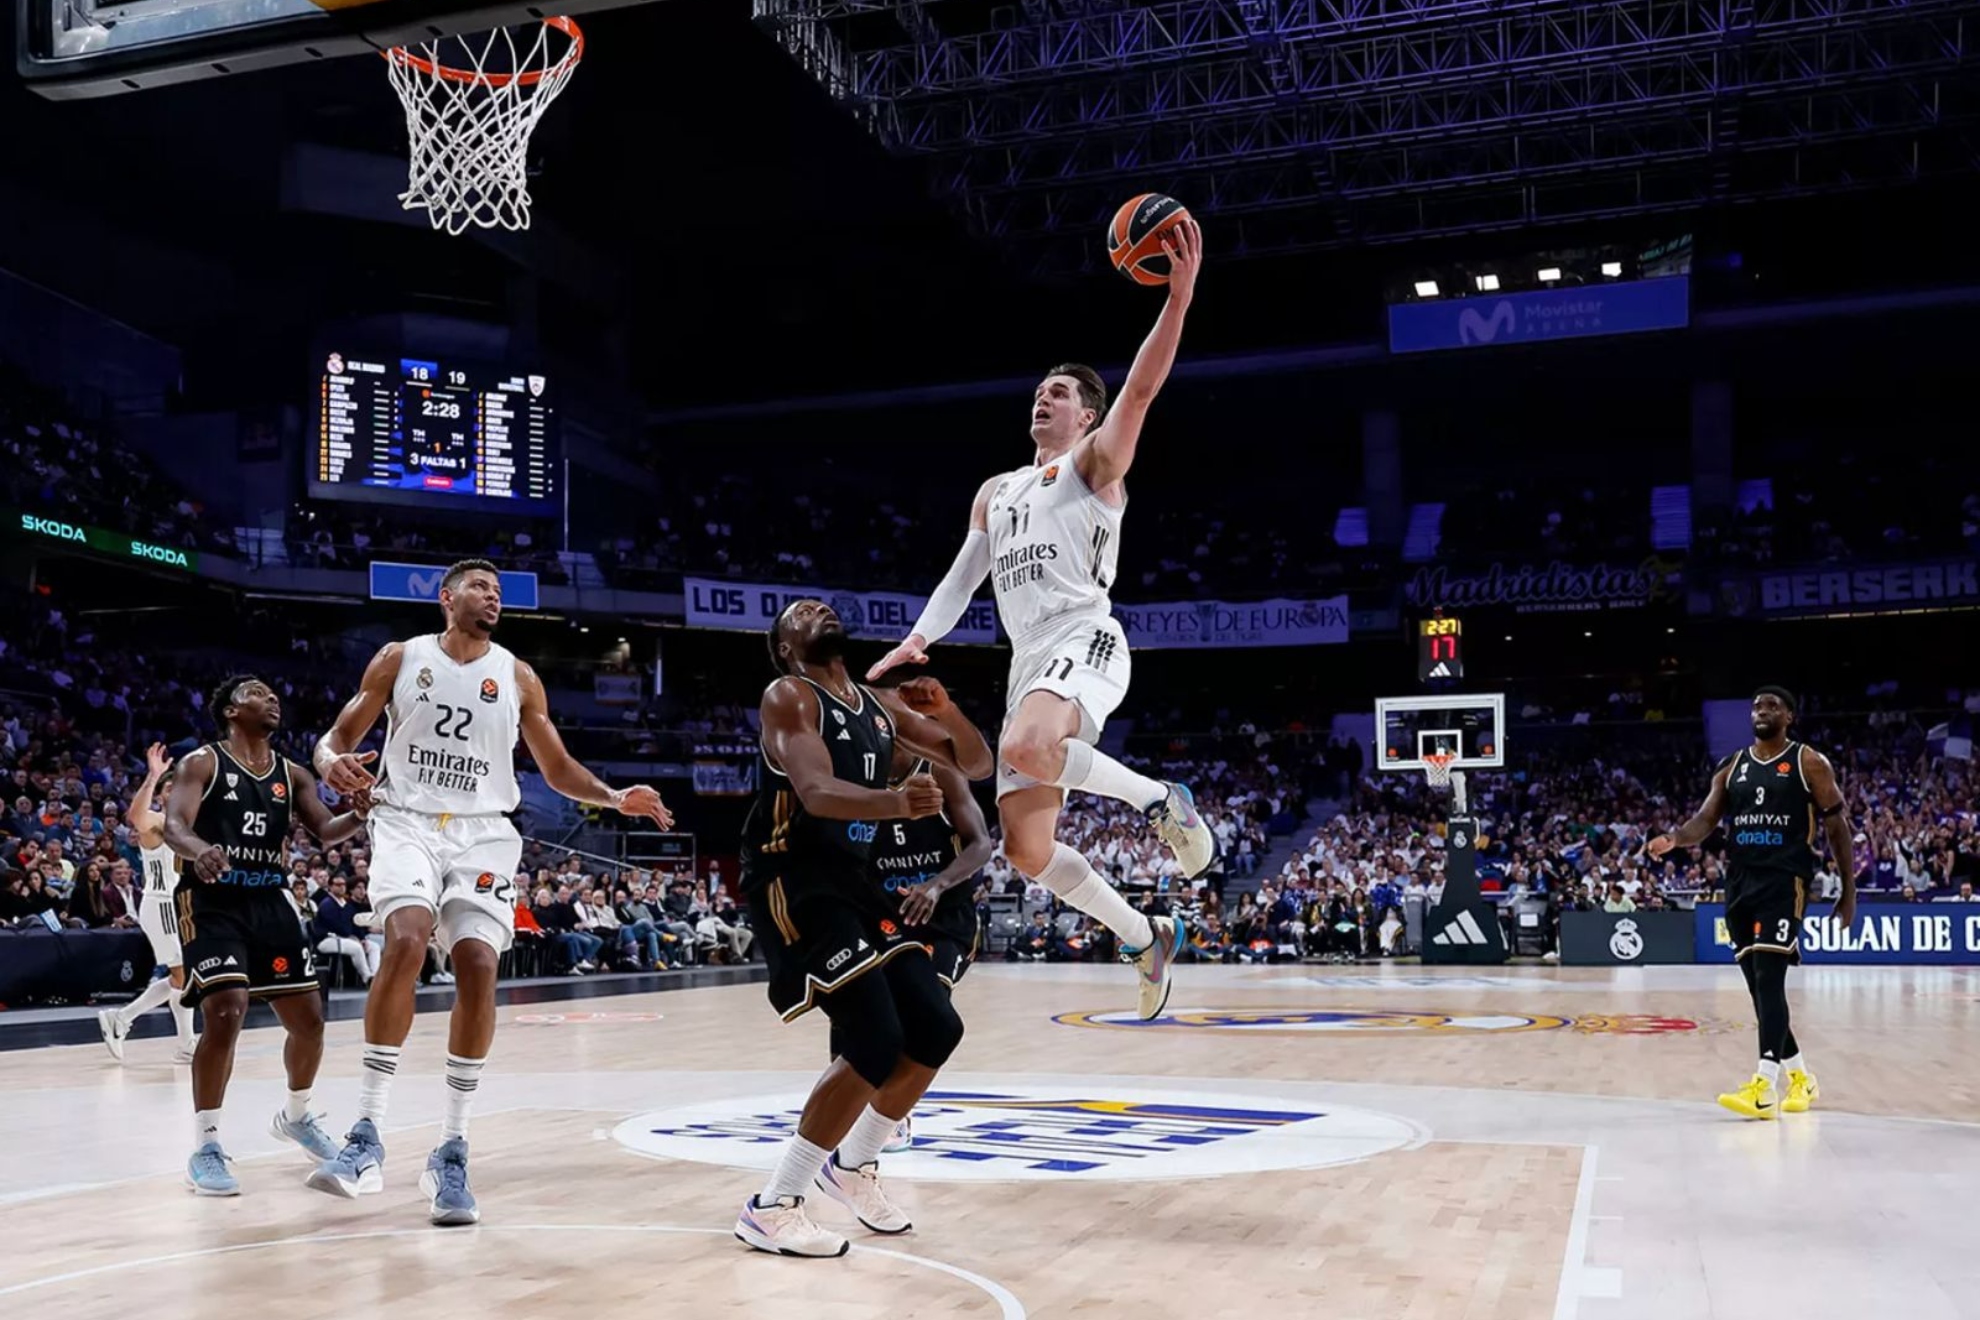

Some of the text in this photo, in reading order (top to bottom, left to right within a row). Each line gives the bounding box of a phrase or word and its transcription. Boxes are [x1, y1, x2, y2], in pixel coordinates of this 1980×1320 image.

[1524, 301, 1603, 319] Movistar
[411, 366, 429, 380] 18
[448, 371, 466, 385] 19
[422, 400, 460, 419] 2:28
[410, 452, 466, 469] 3 FALTAS 1
[21, 513, 87, 543] SKODA
[130, 541, 188, 566] SKODA
[1405, 561, 1652, 608] Madridistas
[693, 586, 744, 614] LOS
[868, 600, 912, 626] DEL
[1129, 611, 1199, 632] REYES
[1215, 609, 1244, 631] DE
[1432, 636, 1455, 660] 17
[433, 704, 474, 741] 22
[408, 744, 490, 776] Emirates
[418, 768, 478, 793] FLY BETTER
[1755, 786, 1765, 805] 3
[242, 811, 267, 837] 25
[893, 823, 907, 846] 5
[1736, 829, 1783, 846] dnata
[212, 843, 282, 866] MNIYA
[1776, 919, 1790, 943] 3
[1803, 916, 1901, 952] SOLAN
[1912, 916, 1952, 951] DE
